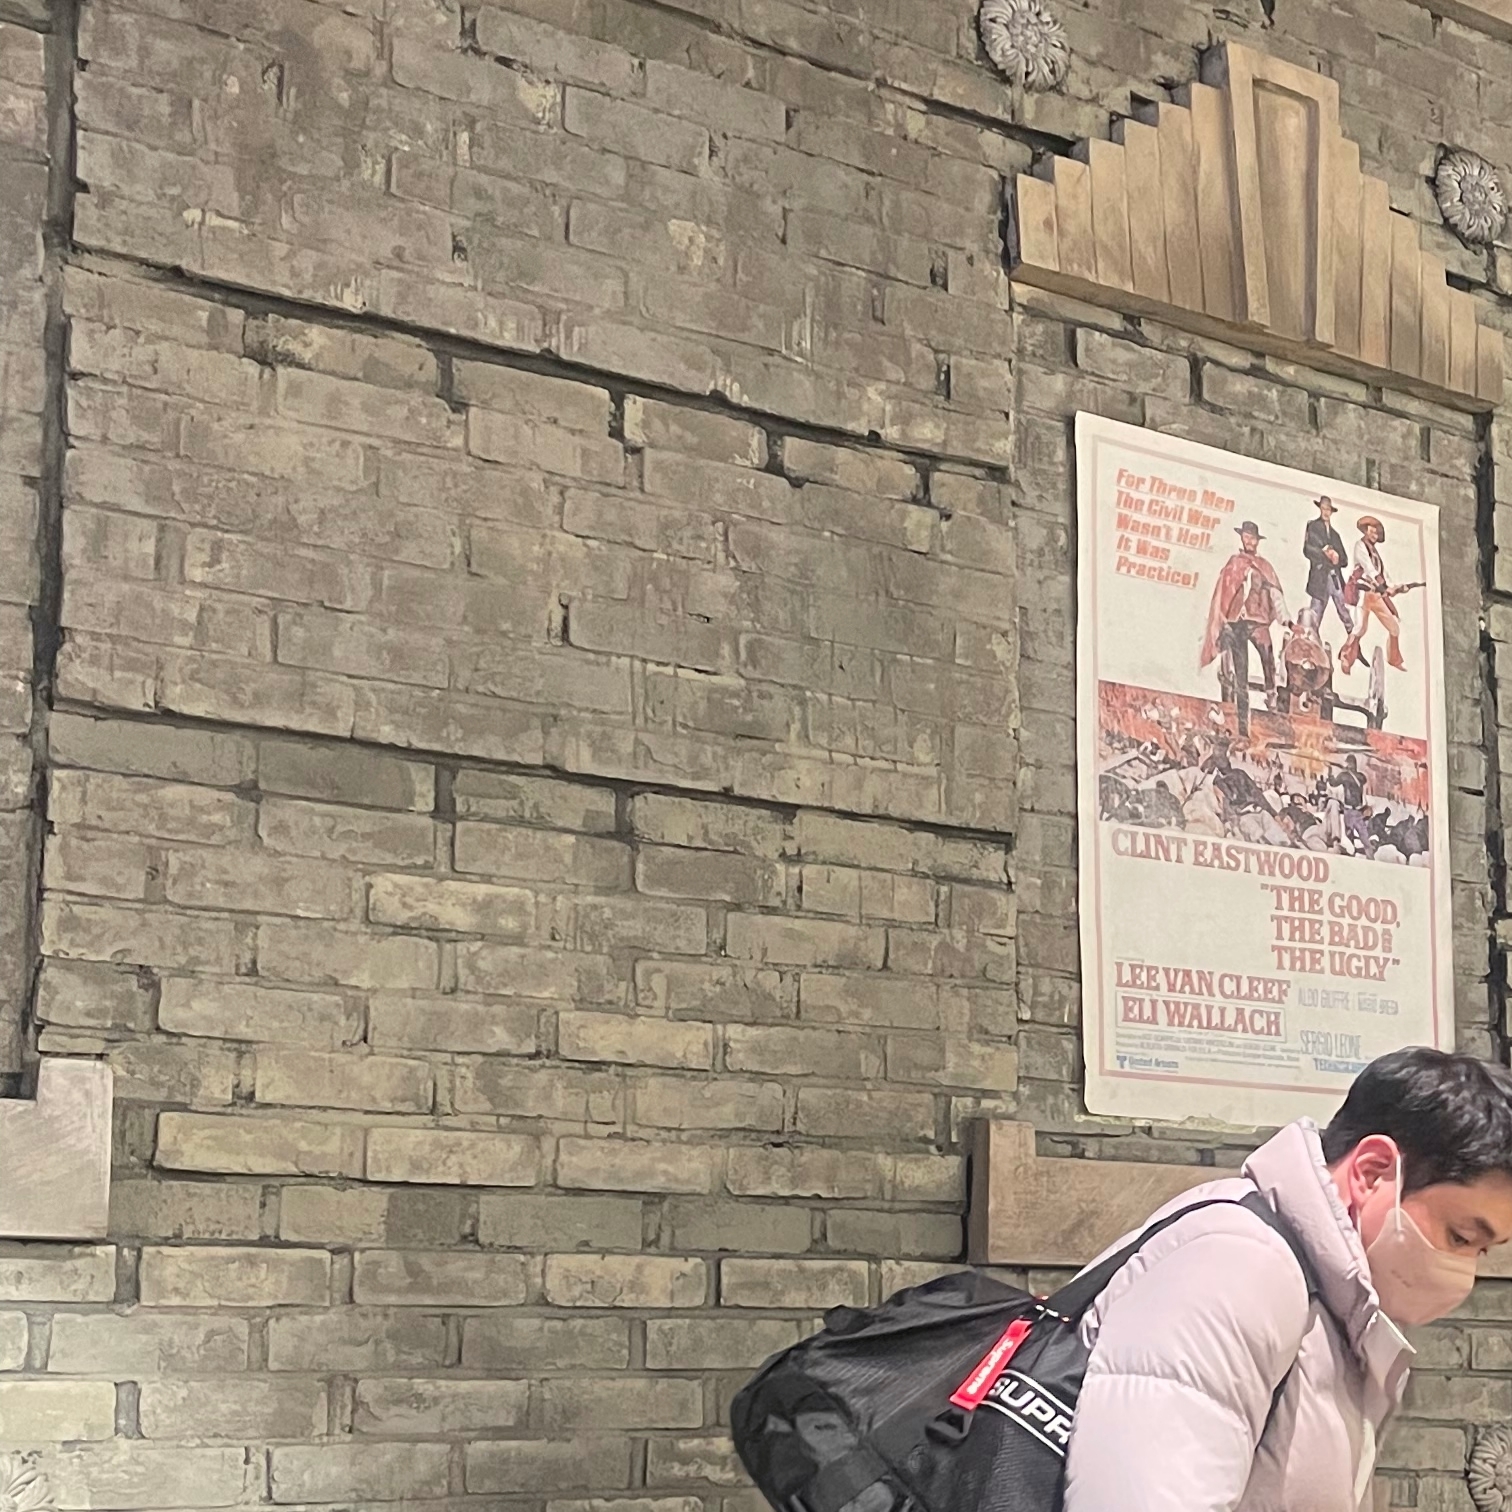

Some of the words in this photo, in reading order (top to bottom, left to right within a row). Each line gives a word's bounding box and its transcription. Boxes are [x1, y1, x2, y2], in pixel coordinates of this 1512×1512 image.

[1116, 467, 1146, 490] For
[1149, 475, 1198, 503] Three
[1201, 489, 1235, 513] Men
[1116, 489, 1145, 512] The
[1148, 498, 1185, 522] Civil
[1187, 507, 1221, 530] War
[1116, 511, 1173, 541] Wasn't
[1116, 534, 1132, 551] It
[1136, 538, 1170, 561] Was
[1116, 555, 1199, 588] Practice!
[1111, 828, 1187, 863] CLINT
[1192, 839, 1330, 883] EASTWOOD
[1270, 914, 1324, 945] THE
[1327, 920, 1379, 951] BAD
[1271, 944, 1325, 974] THE
[1114, 962, 1160, 991] LEE
[1162, 967, 1215, 997] VAN
[1218, 973, 1291, 1004] CLEEF
[1121, 996, 1159, 1025] ELI
[1162, 1000, 1282, 1036] WALLACH
